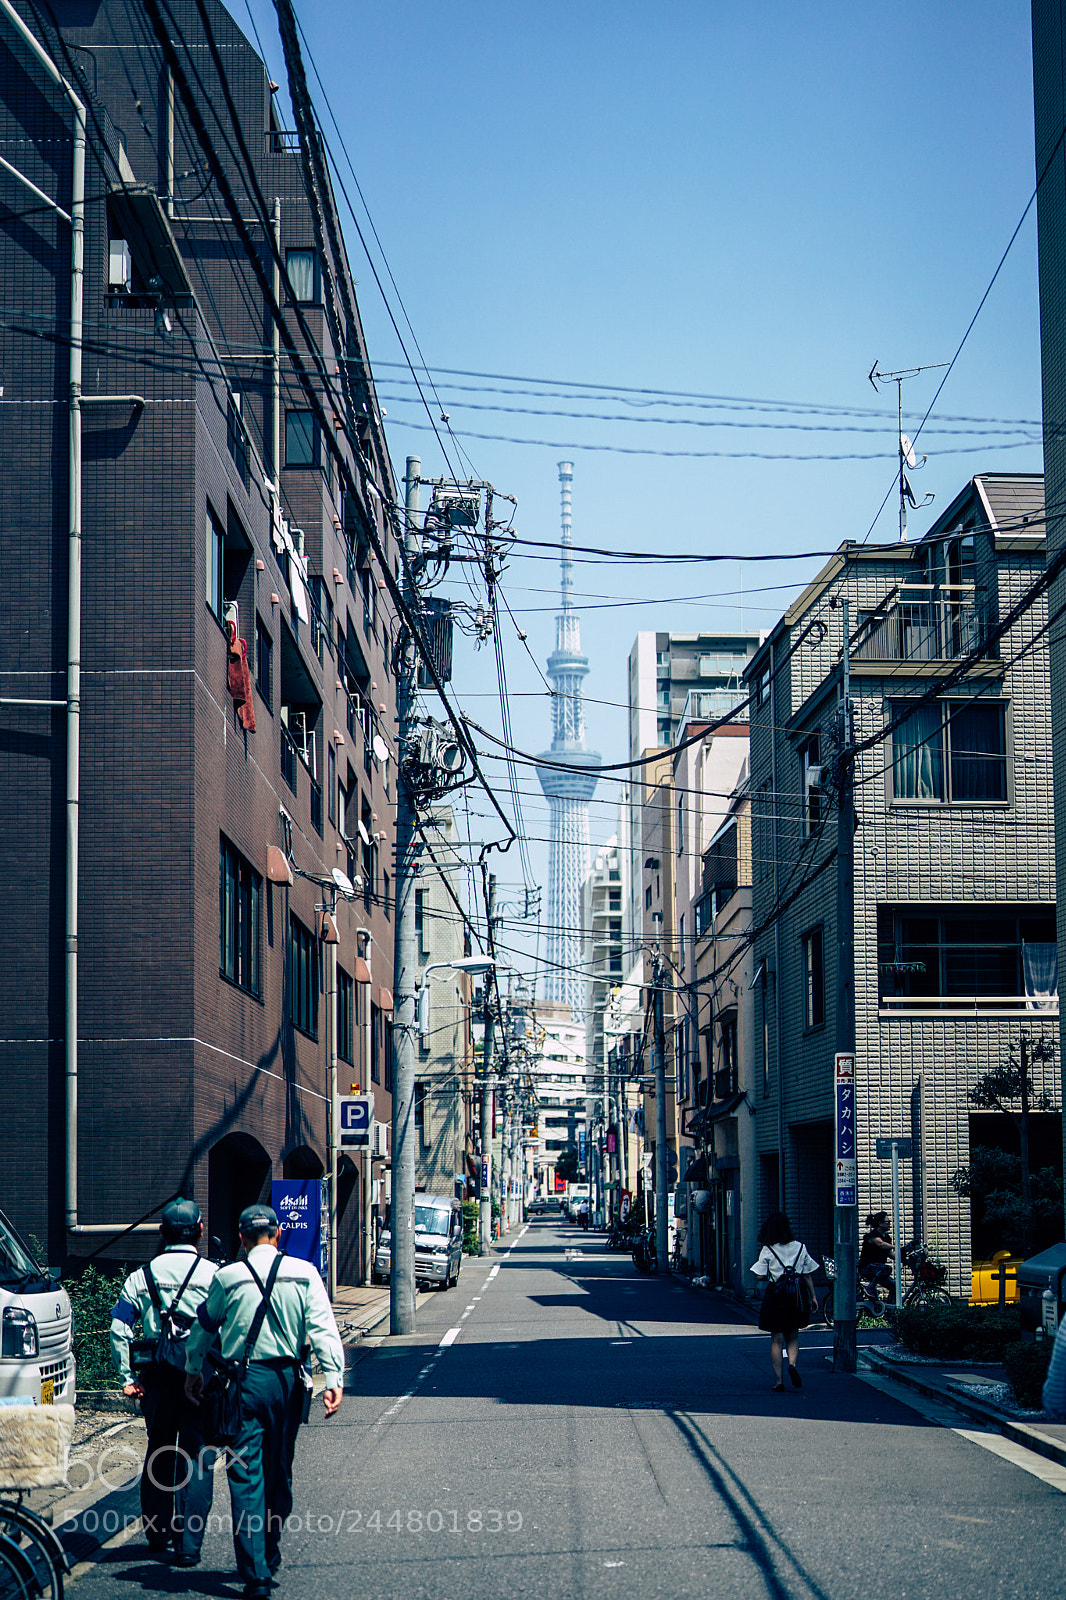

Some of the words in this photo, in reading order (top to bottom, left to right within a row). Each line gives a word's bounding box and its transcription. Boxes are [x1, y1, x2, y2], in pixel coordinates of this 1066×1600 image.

[839, 1059, 853, 1075] 質
[347, 1105, 365, 1127] P
[841, 1088, 852, 1154] タカハシ
[280, 1194, 308, 1206] Asahi
[280, 1222, 308, 1231] CALPIS
